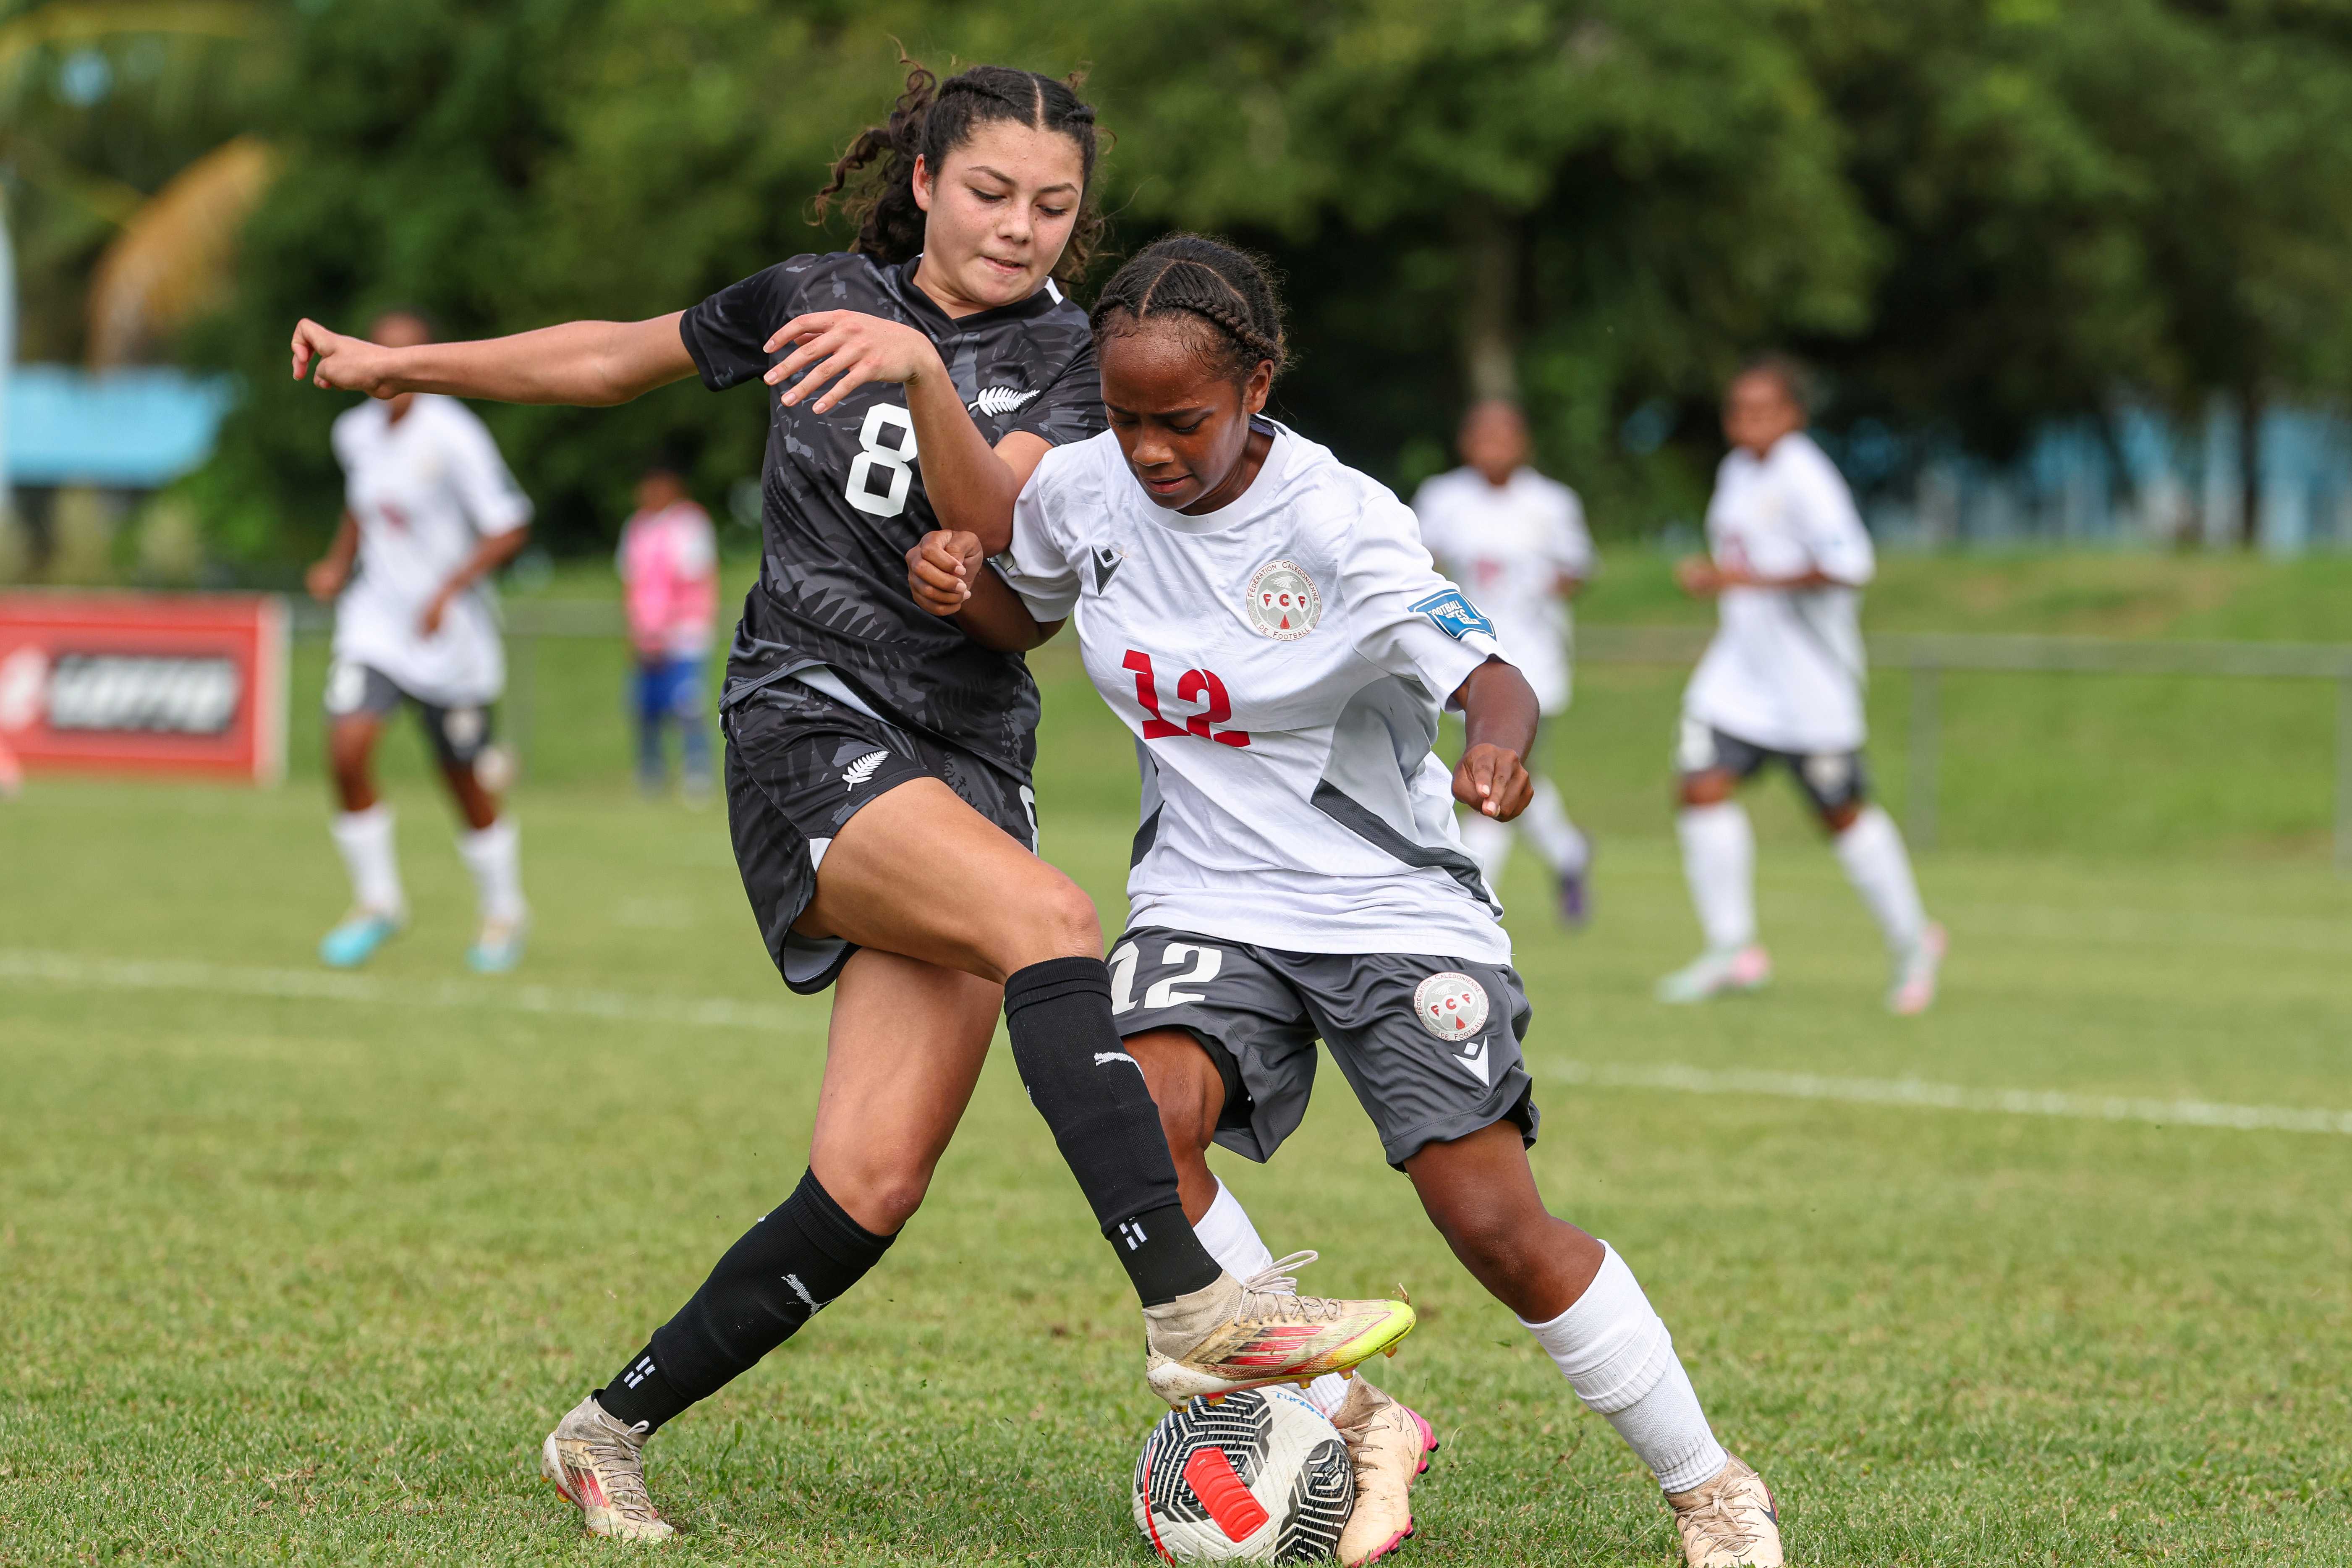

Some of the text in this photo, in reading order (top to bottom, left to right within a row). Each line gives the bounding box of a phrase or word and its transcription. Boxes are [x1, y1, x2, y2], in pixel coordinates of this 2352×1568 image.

[845, 402, 918, 518] 8
[1248, 562, 1319, 601] FÉDÉRATION CALÉDONIENNE
[1259, 624, 1310, 640] DE FOOTBALL
[1122, 649, 1251, 748] 12
[1109, 941, 1222, 1015] 12
[1415, 973, 1482, 1015] FÉDÉRATION CALÉDONIENNE
[1455, 1017, 1485, 1039] FOOTBALL
